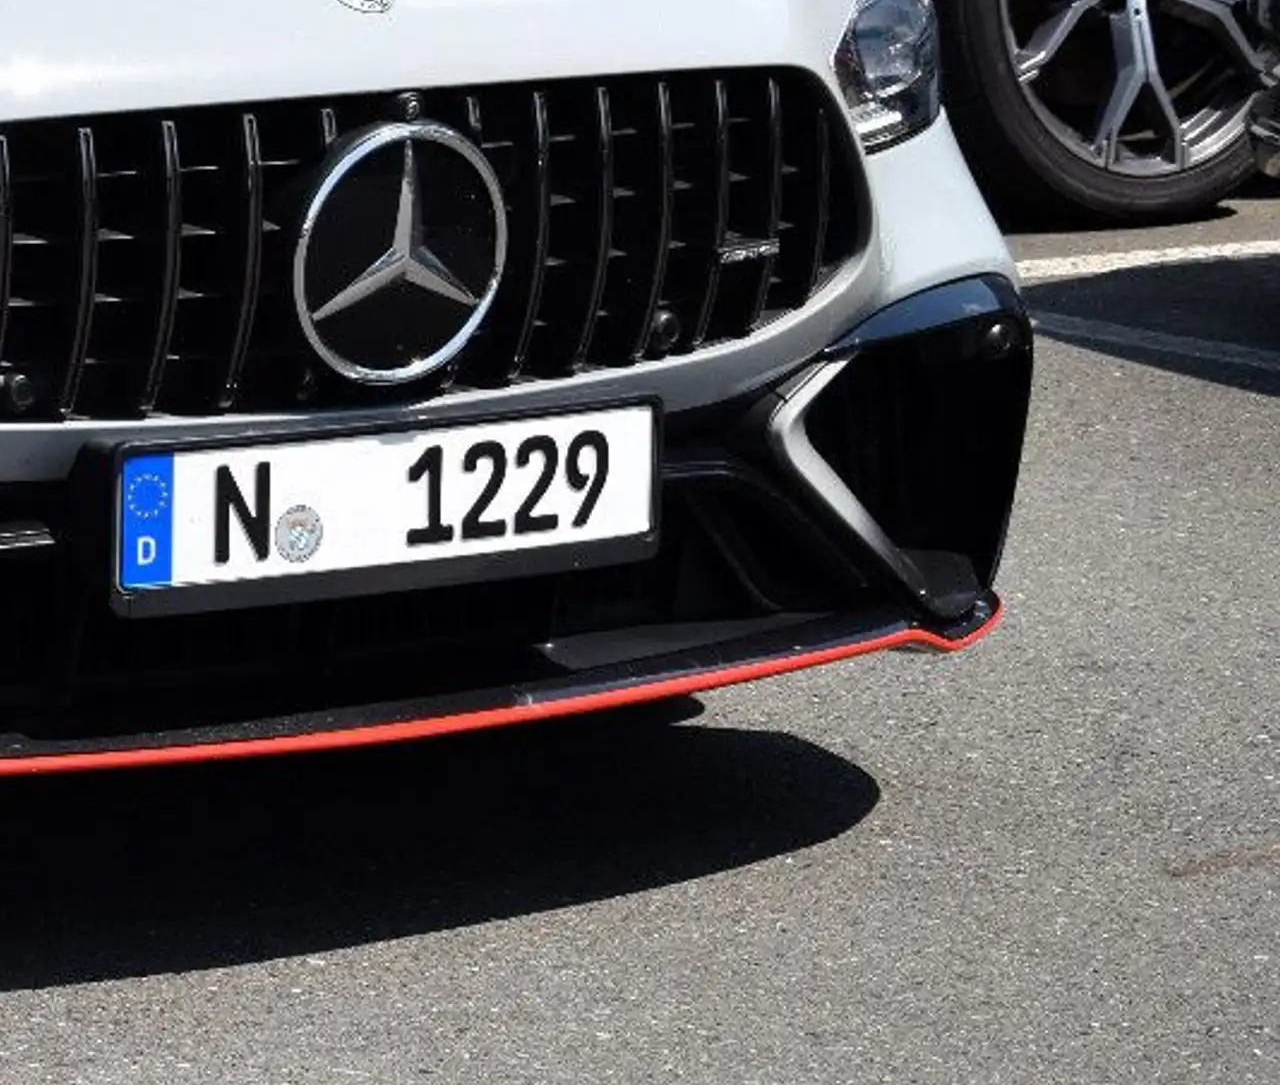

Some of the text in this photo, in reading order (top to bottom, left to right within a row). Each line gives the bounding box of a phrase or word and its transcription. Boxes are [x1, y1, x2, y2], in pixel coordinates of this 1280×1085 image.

[214, 461, 271, 564] N
[406, 430, 609, 547] 1229
[137, 536, 156, 565] D
